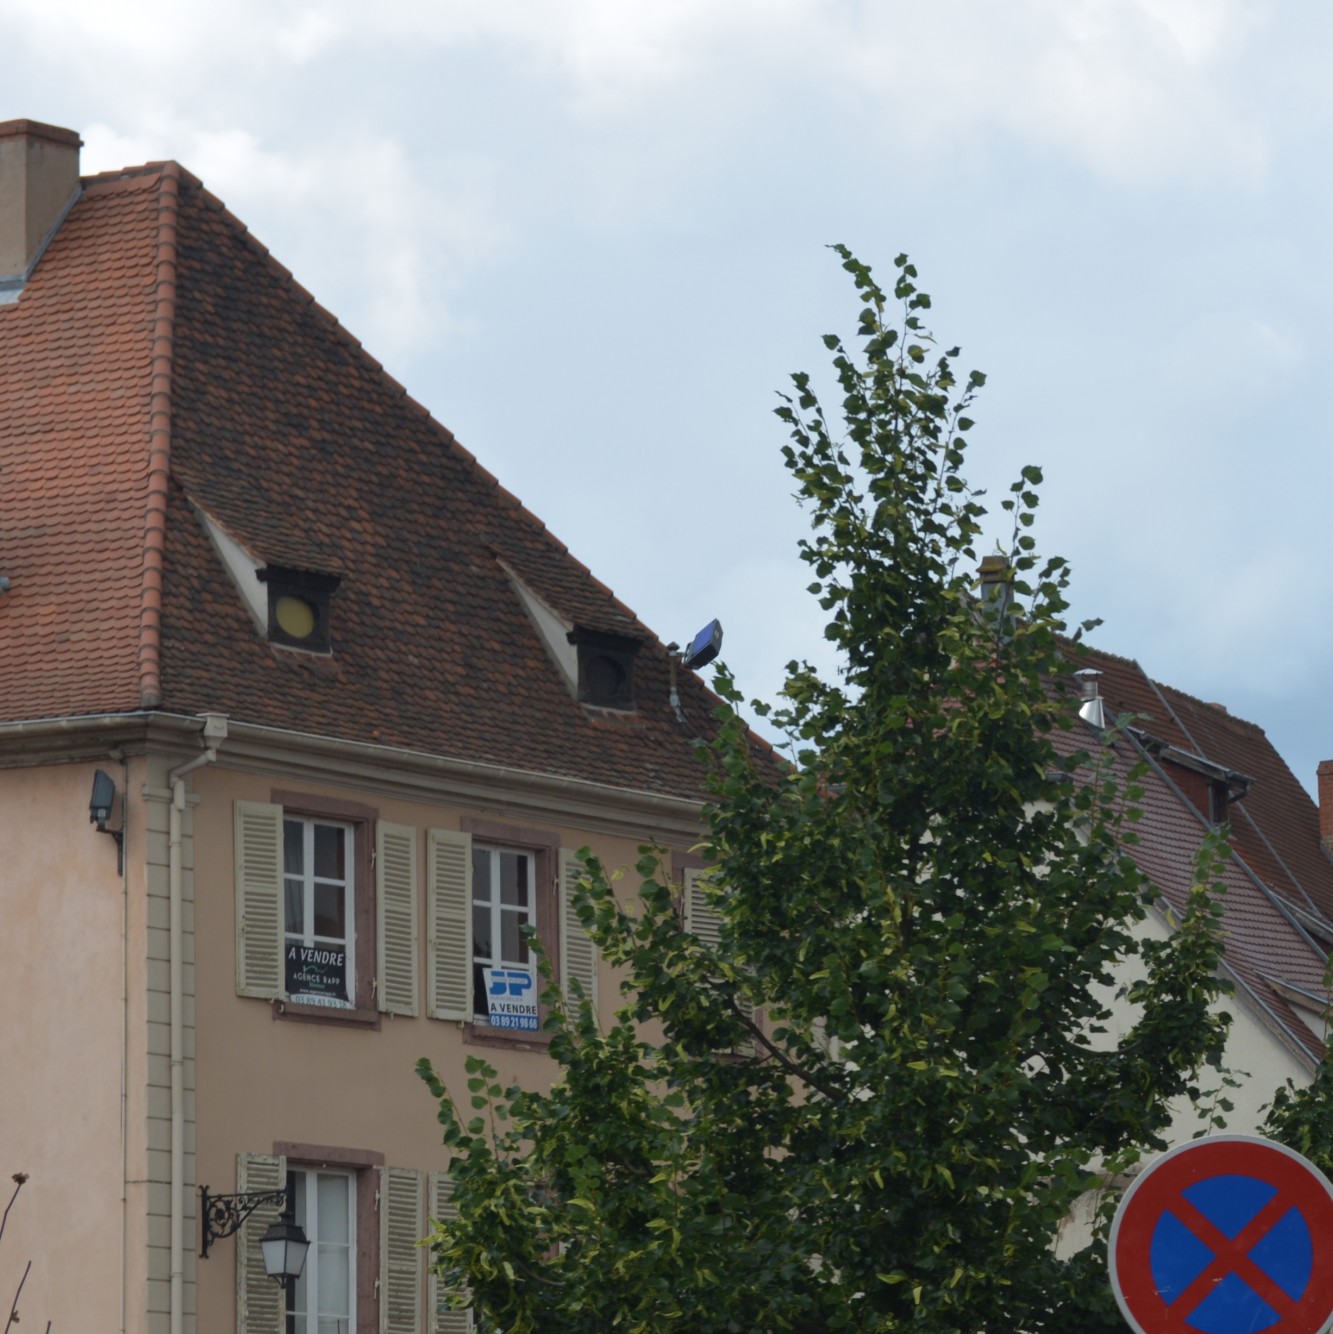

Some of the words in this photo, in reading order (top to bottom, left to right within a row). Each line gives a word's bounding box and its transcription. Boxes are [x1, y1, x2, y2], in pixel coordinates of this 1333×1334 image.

[288, 947, 296, 960] A
[300, 948, 344, 966] VENDRE
[293, 972, 320, 983] AGENCE
[490, 1003, 497, 1012] A
[500, 1003, 537, 1015] VENDRE
[491, 1015, 500, 1027] 03
[510, 1016, 519, 1028] 21
